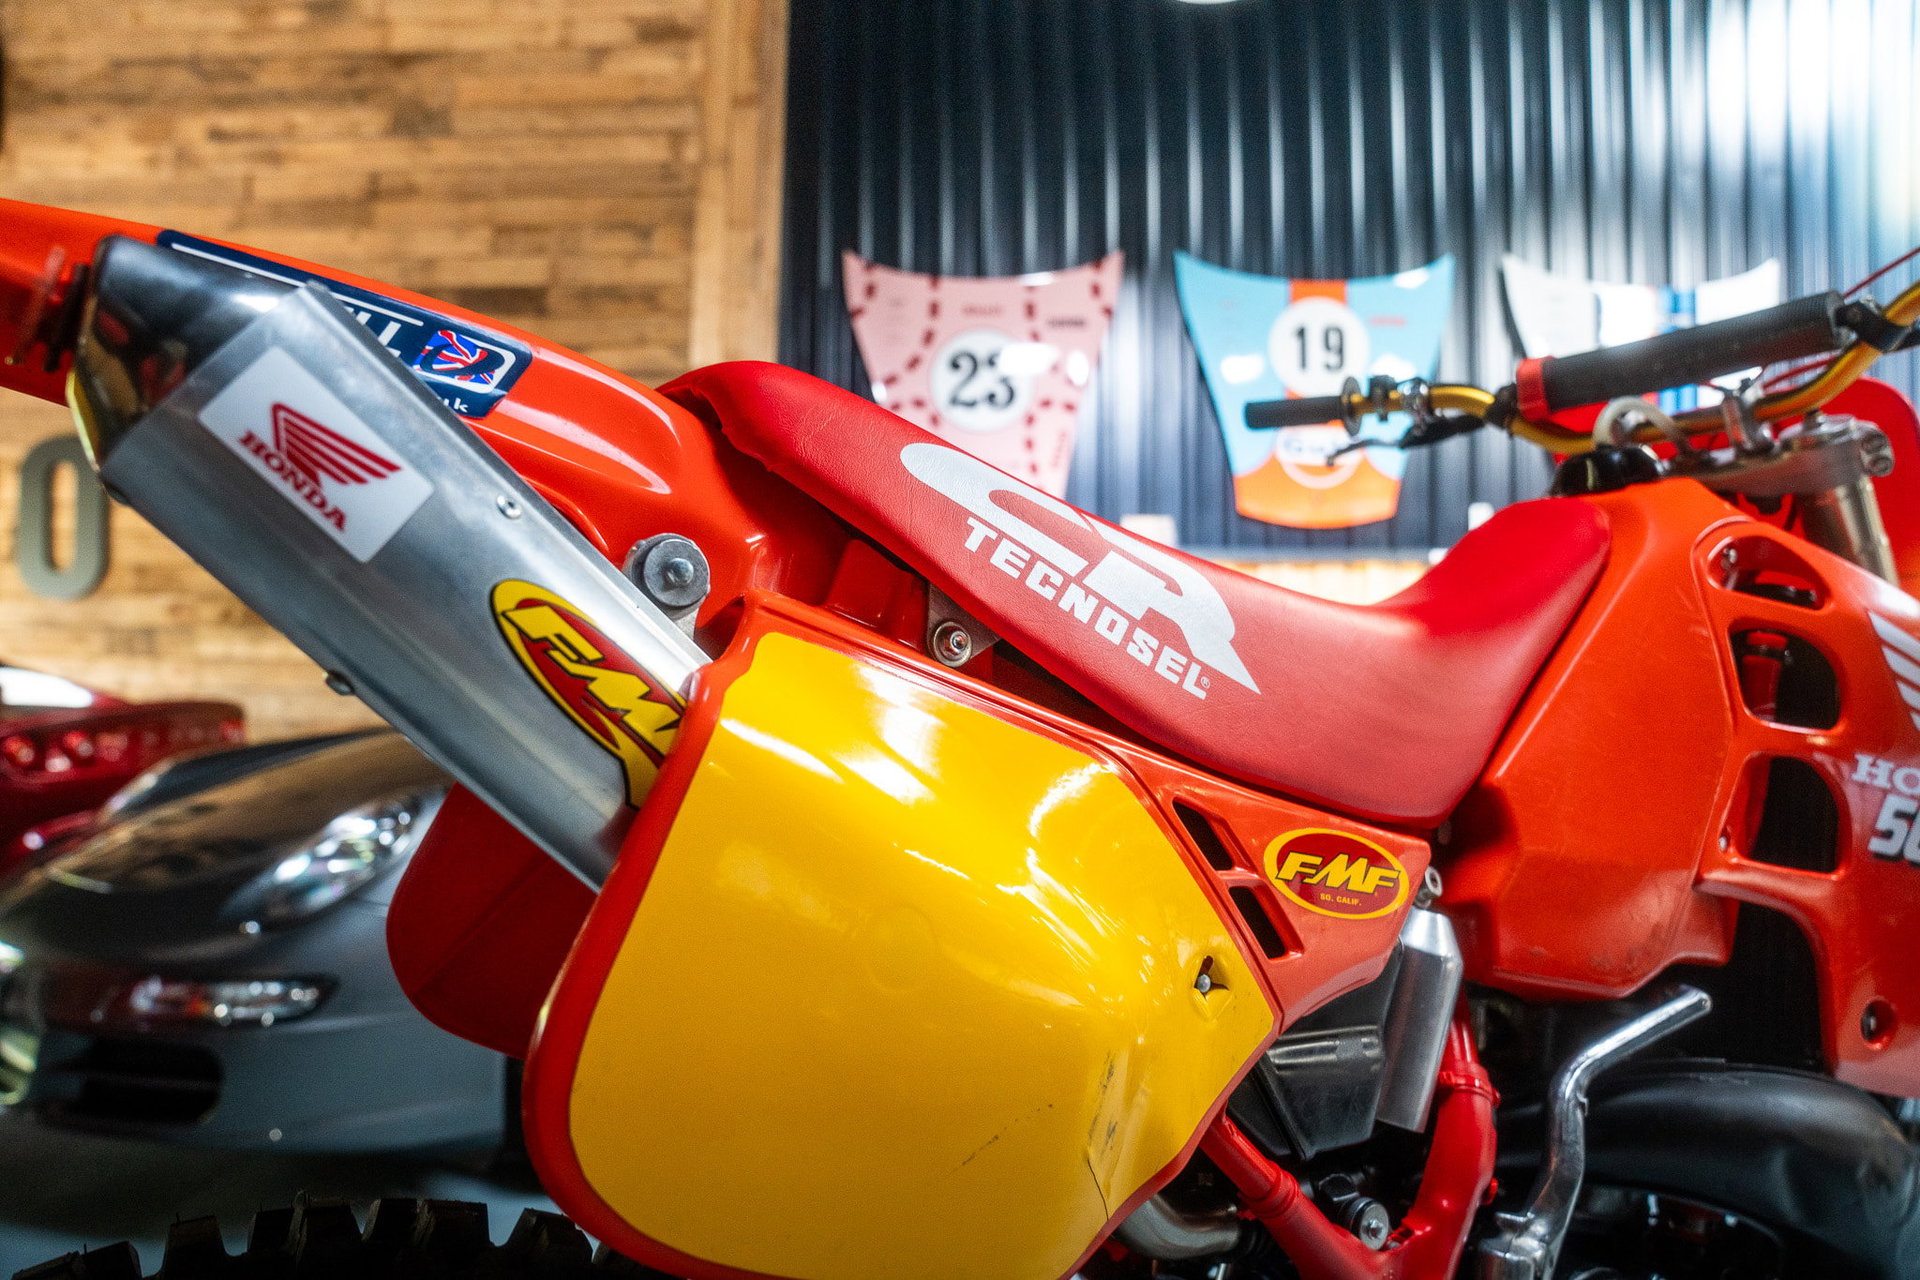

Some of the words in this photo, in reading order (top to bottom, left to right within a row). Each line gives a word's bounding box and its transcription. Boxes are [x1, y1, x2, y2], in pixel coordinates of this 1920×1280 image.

[1293, 325, 1346, 372] 19
[947, 350, 1016, 408] 23
[238, 429, 347, 533] HONDA
[1276, 851, 1401, 894] FMF
[1336, 895, 1362, 906] CALIF.
